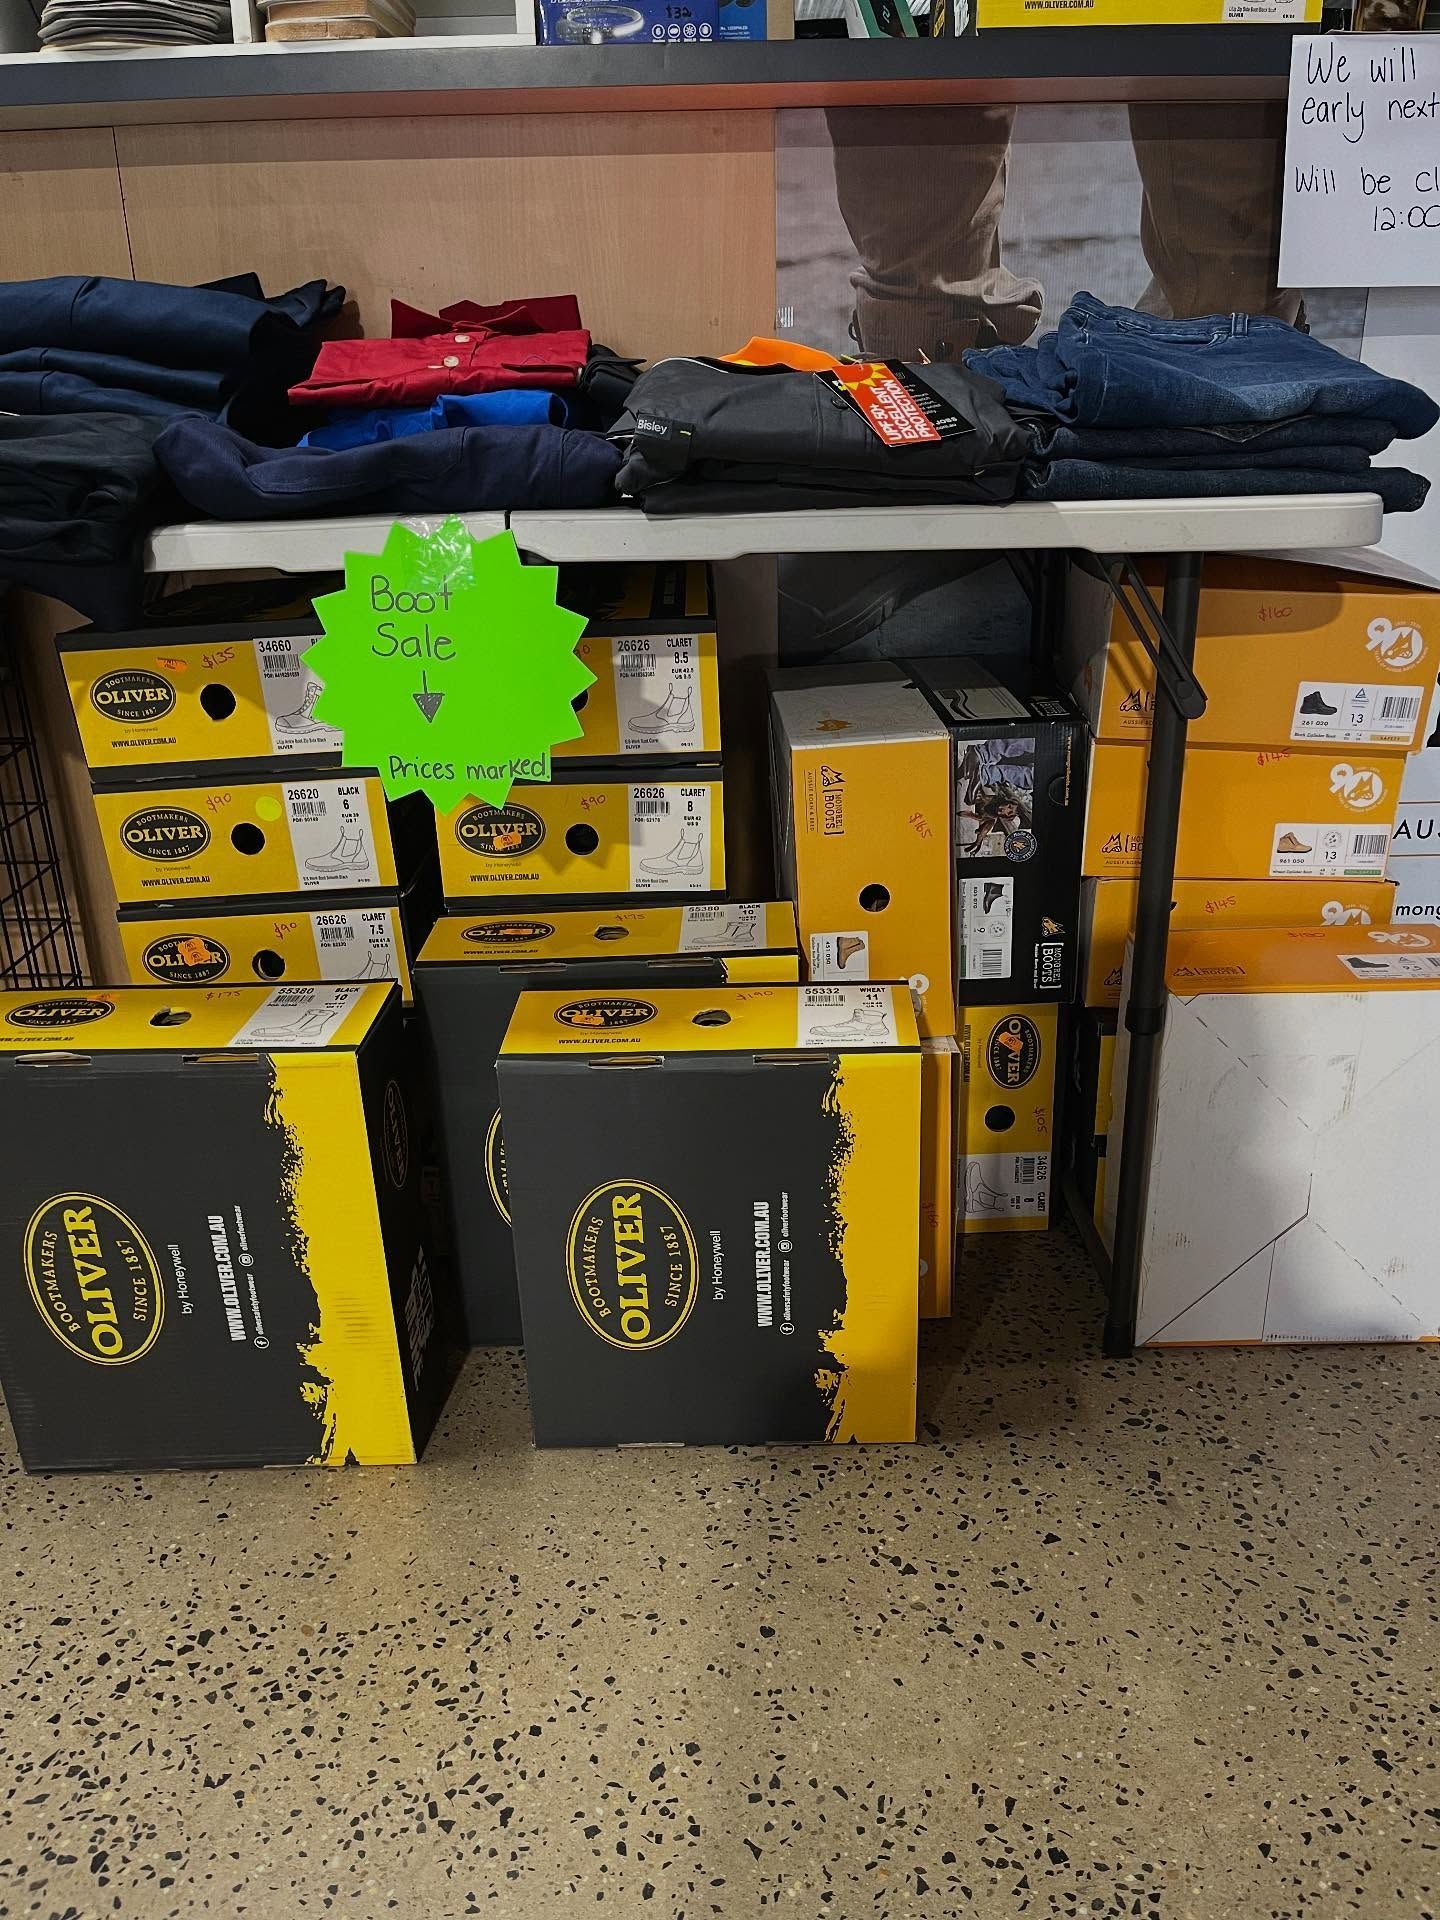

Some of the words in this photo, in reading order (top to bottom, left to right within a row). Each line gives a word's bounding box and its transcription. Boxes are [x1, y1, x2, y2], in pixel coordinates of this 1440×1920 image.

[1024, 1, 1094, 9] WWW.OLIVER.COM.AU
[1307, 42, 1351, 85] We
[1370, 47, 1416, 83] will
[1301, 91, 1365, 143] early
[1388, 91, 1440, 121] next
[1295, 164, 1336, 194] Will
[1360, 167, 1392, 196] be
[870, 403, 889, 421] 50+
[870, 386, 918, 440] EXCELLENT
[881, 379, 935, 438] PROTECTION
[637, 419, 668, 435] Bisley
[879, 420, 902, 441] UPF
[370, 575, 453, 614] Boot
[1258, 607, 1293, 622] $160
[258, 640, 292, 652] 34660
[371, 622, 456, 661] Sale
[618, 640, 650, 652] 26626
[666, 638, 693, 647] CLARET
[201, 647, 235, 669] $135
[674, 652, 689, 664] 8.5
[105, 676, 155, 689] BOOTMAKERS
[96, 688, 170, 705] OLIVER
[117, 709, 140, 717] SINCE
[1350, 713, 1364, 724] 13
[111, 737, 177, 748] WWW.OLIVER.COM.AU
[1257, 747, 1292, 766] $145
[388, 755, 455, 780] Prices
[287, 789, 319, 801] 26620
[337, 787, 360, 796] BLACK
[633, 788, 665, 799] 26626
[680, 788, 706, 797] CLARET
[206, 793, 232, 813] $90
[343, 799, 349, 810] 6
[580, 794, 606, 811] $90
[687, 801, 693, 812] 8
[136, 813, 188, 826] BOOTMAKERS
[825, 795, 835, 830] BOOTS
[126, 825, 204, 843] OLIVER
[461, 822, 539, 838] OLIVER
[1392, 819, 1440, 840] AU
[147, 847, 172, 856] SINCE
[174, 845, 190, 855] 1887
[1324, 851, 1337, 860] 13
[141, 875, 211, 887] WWW.OLIVER.COM.AU
[470, 873, 539, 882] WWW.OLIVER.COM.AU
[1203, 895, 1237, 914] $145
[316, 914, 347, 926] 26626
[361, 913, 386, 922] CLARET
[273, 922, 297, 940] $90
[369, 924, 384, 935] 7.5
[149, 950, 223, 968] OLIR
[1042, 948, 1054, 983] BOOTS
[1053, 947, 1062, 982] MONGREL
[169, 971, 192, 979] SINCE
[194, 969, 210, 978] 1887
[204, 989, 242, 1000] $175
[14, 1007, 104, 1017] OLIVER
[561, 1008, 649, 1017] OLIVER
[1023, 1029, 1034, 1073] BOOTMAKERS
[1033, 1106, 1048, 1134] $105
[1036, 1155, 1048, 1180] 34626
[1036, 1191, 1046, 1212] CLARET
[780, 1192, 788, 1238] oliverfootwear
[234, 1205, 248, 1251] oliverfootwear
[659, 1226, 682, 1257] 1887
[116, 1240, 142, 1271] 1887
[710, 1230, 725, 1285] Honeywell
[753, 1201, 773, 1327] WWW.OLIVER.COM.AU
[168, 1244, 187, 1299] Honeywell
[583, 1216, 611, 1318] BOOTMAKERS
[612, 1193, 650, 1341] OLIVER
[41, 1230, 82, 1333] BOOTMAKERS
[63, 1205, 123, 1356] OLIVER
[208, 1215, 246, 1342] WWW.OLIVER.COM.AU
[665, 1263, 683, 1307] SINCE
[133, 1277, 147, 1321] SINCE
[712, 1289, 726, 1301] by
[783, 1259, 792, 1321] oliversafetyfootwear
[181, 1301, 194, 1315] by
